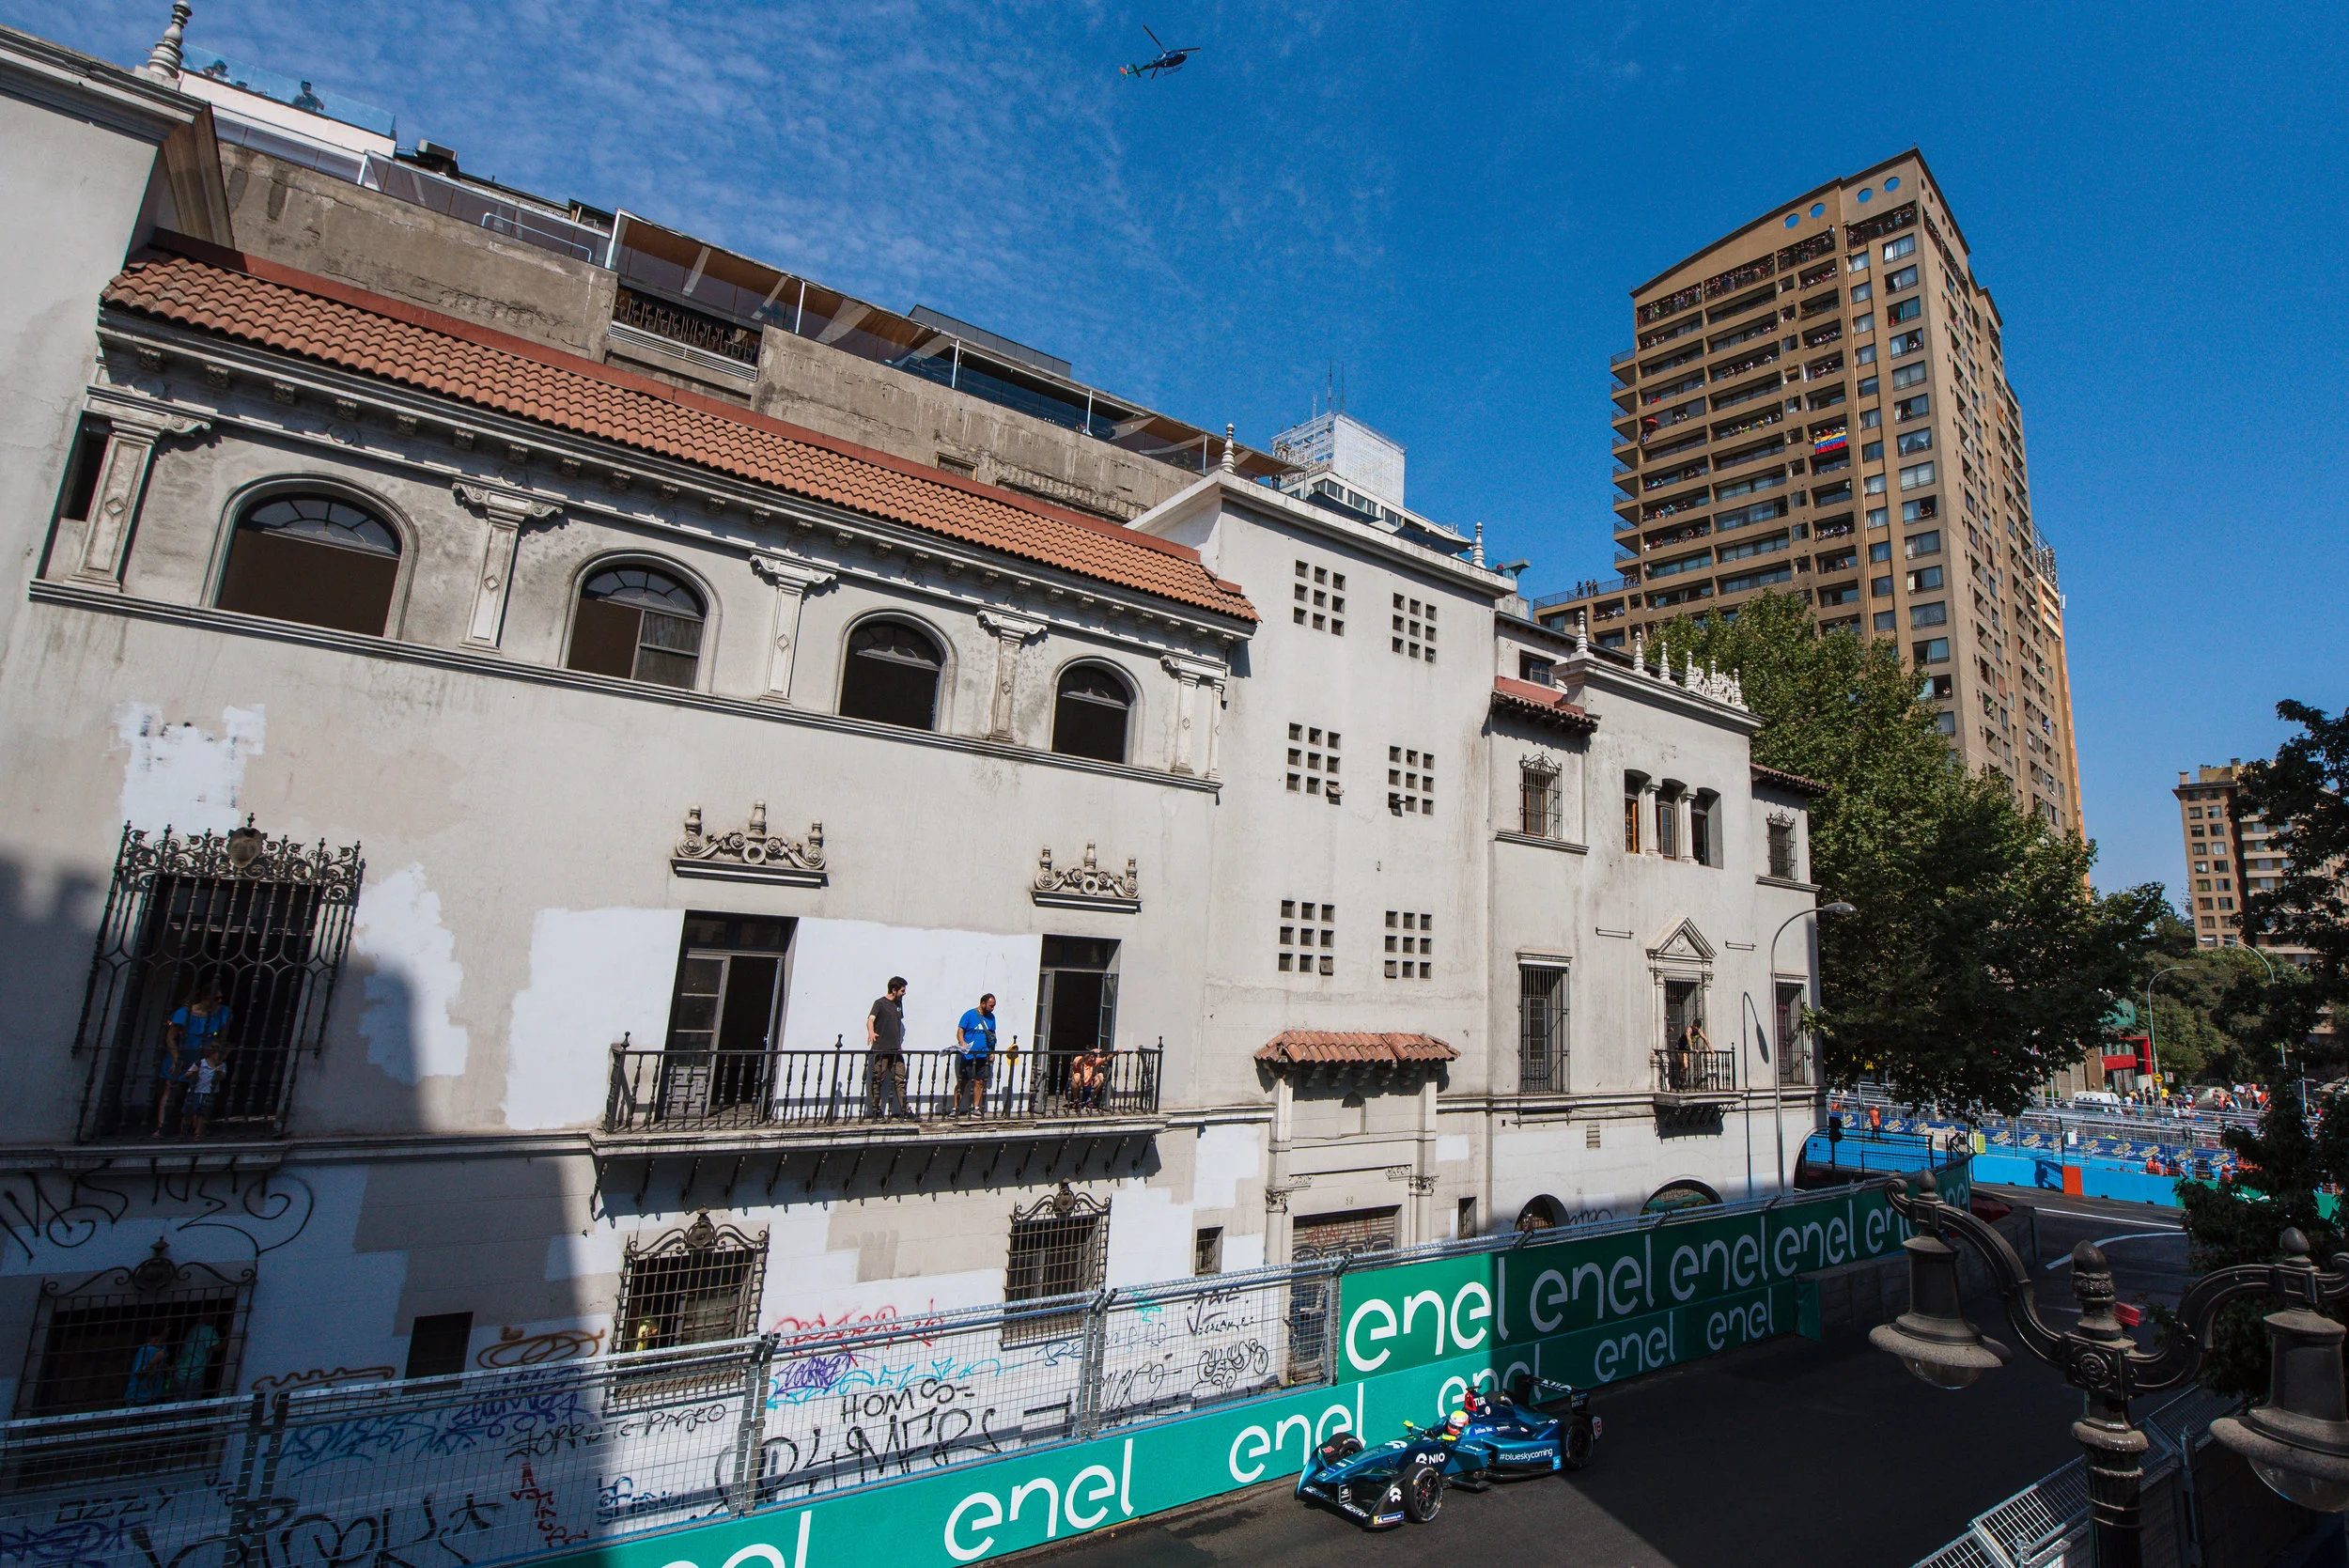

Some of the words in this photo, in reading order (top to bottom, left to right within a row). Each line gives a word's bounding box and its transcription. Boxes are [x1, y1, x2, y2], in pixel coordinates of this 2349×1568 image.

[1346, 1257, 1510, 1372] enel
[1530, 1234, 1655, 1333] enel
[1670, 1215, 1768, 1301] enel
[1774, 1199, 1857, 1277] enel
[1229, 1382, 1366, 1483] enel
[1595, 1311, 1676, 1382] enel
[1707, 1287, 1774, 1351] enel
[945, 1438, 1133, 1560] enel
[1428, 1452, 1446, 1465] NIO
[1499, 1448, 1553, 1462] #blueskycoming
